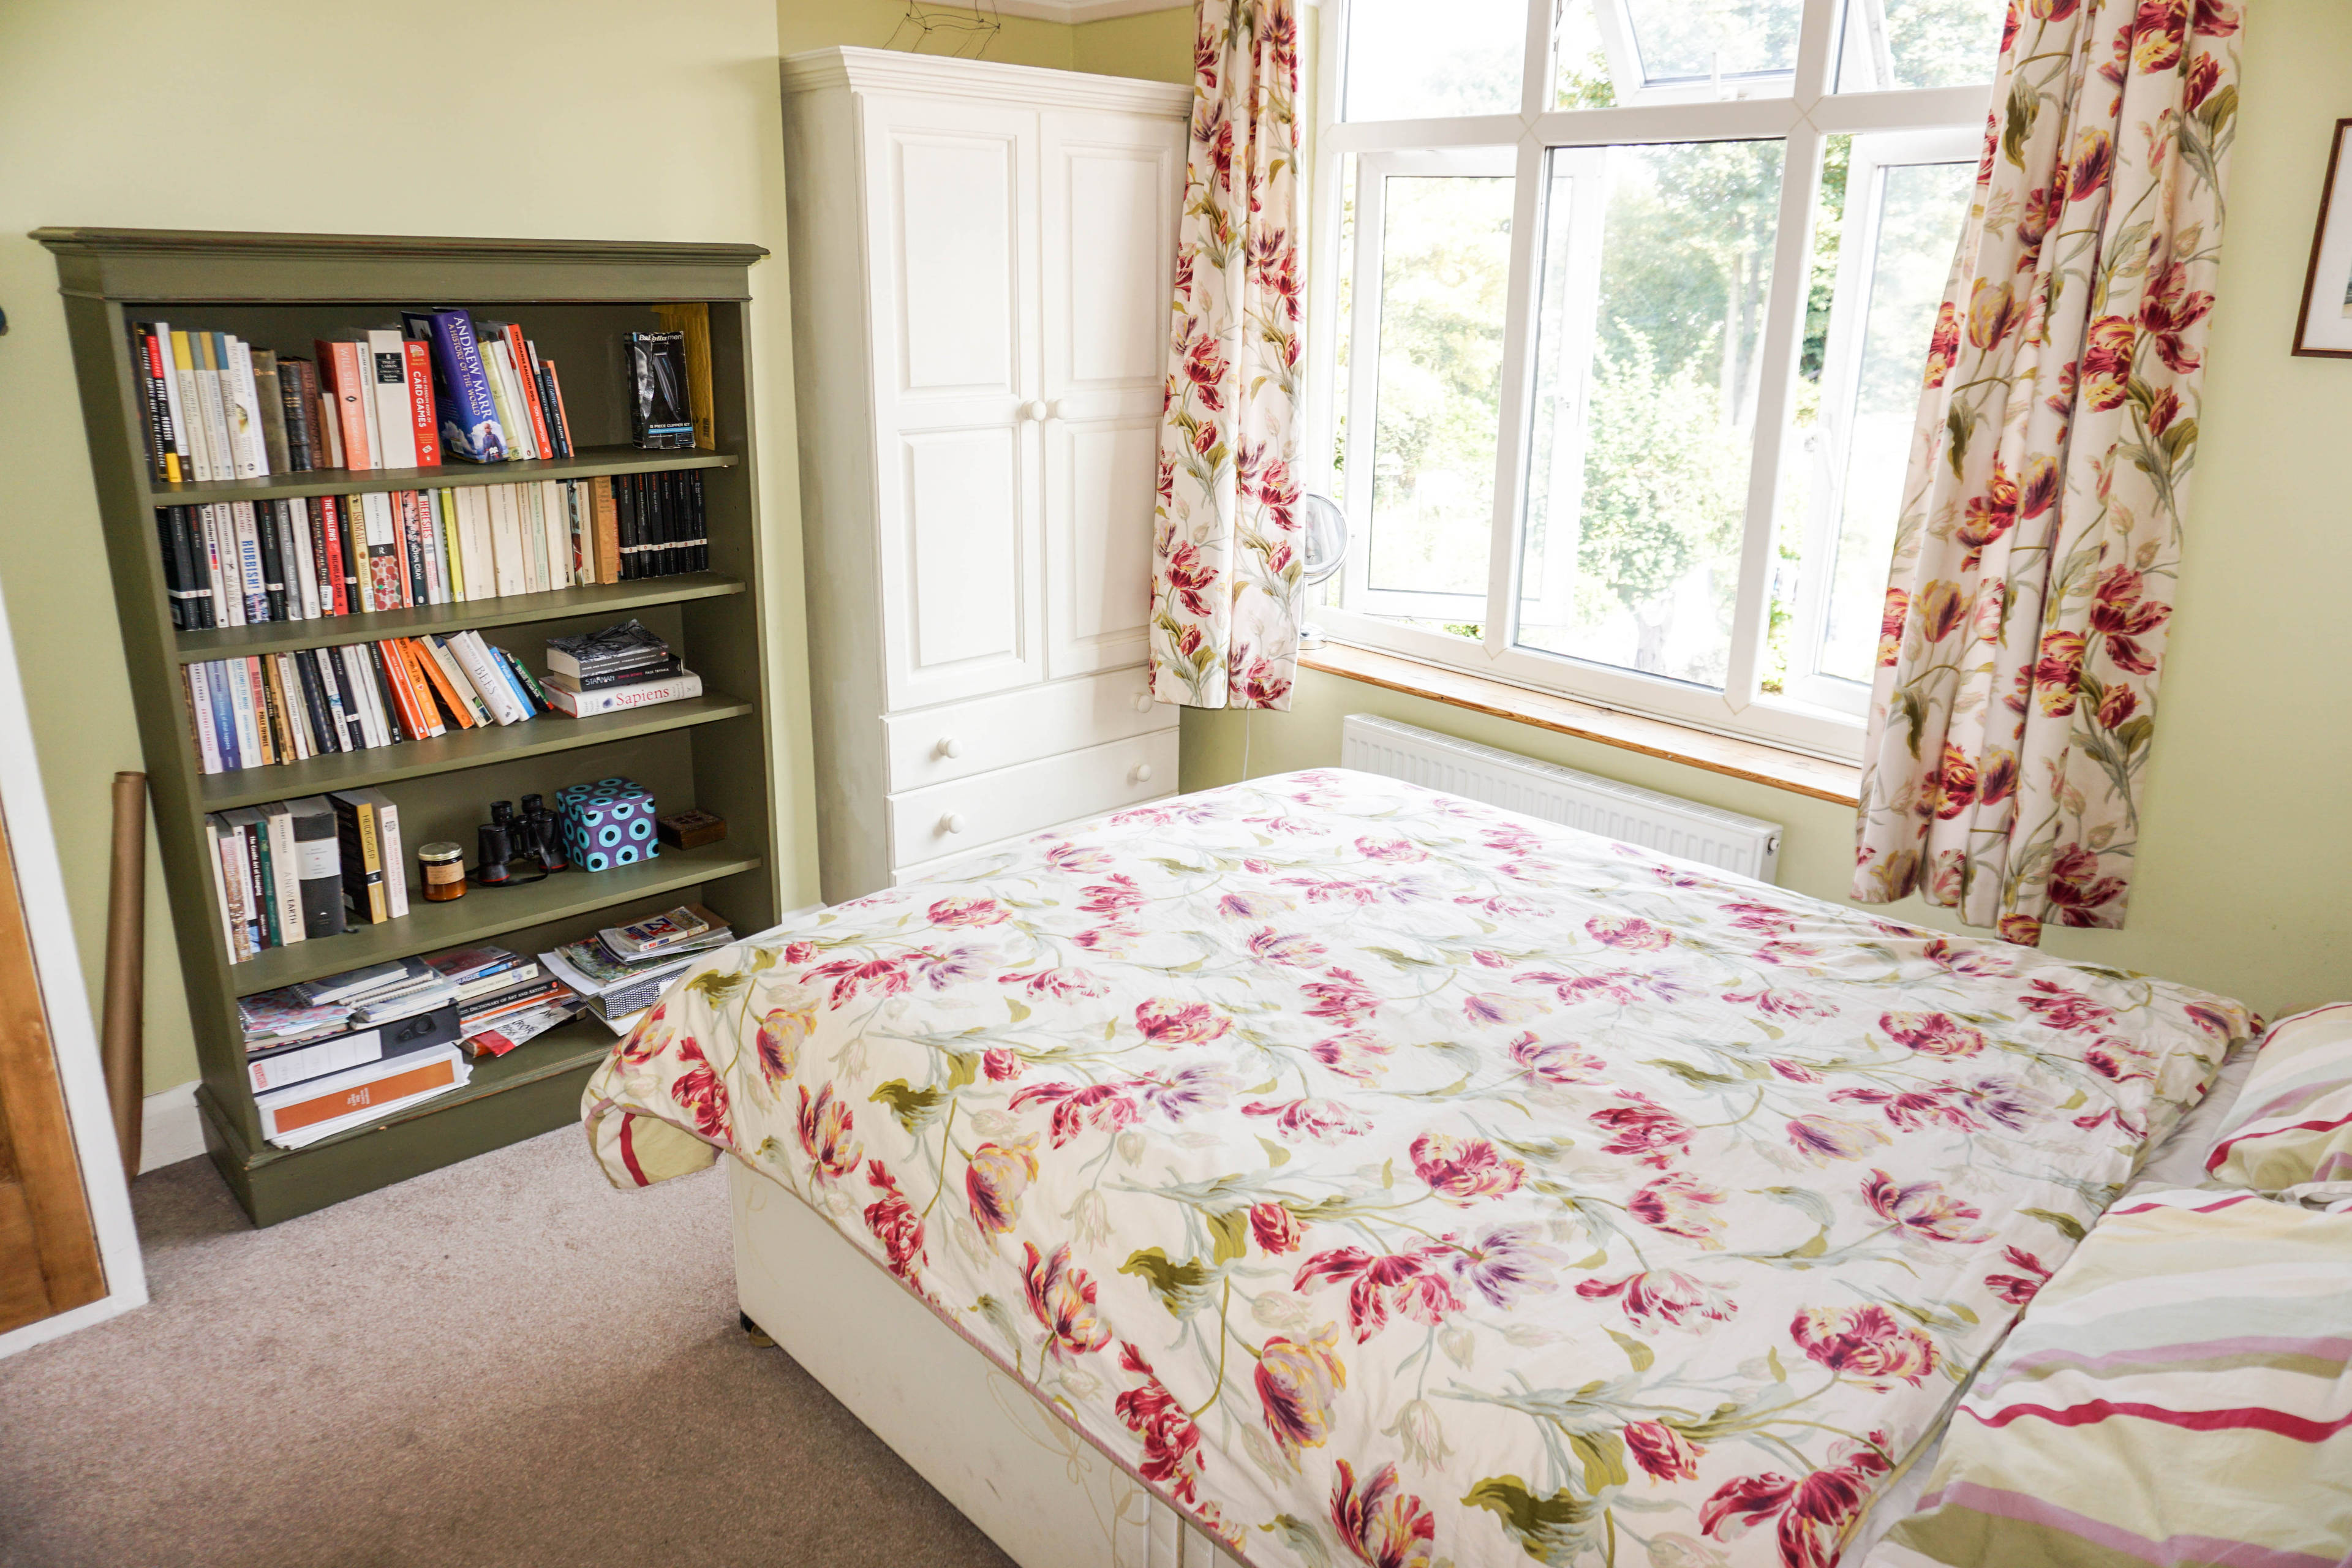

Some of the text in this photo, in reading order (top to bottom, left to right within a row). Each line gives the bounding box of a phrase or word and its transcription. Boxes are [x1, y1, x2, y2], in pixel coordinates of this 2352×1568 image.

[450, 329, 464, 360] HISTORY
[340, 347, 353, 393] WILL SELF
[454, 316, 492, 419] ANDREW MARR
[459, 361, 468, 372] OF
[517, 342, 526, 364] ORANGE
[523, 365, 533, 389] BALLOON
[413, 371, 423, 396] CARD
[462, 373, 472, 388] THE
[416, 397, 427, 427] GAMES
[467, 388, 480, 416] WORLD
[161, 415, 174, 440] MADNESS
[535, 417, 546, 443] THOMPSON
[325, 511, 337, 541] SHALLOWS
[420, 500, 432, 539] HERESIES
[241, 540, 260, 589] RUBBISH!
[331, 554, 341, 582] NICHOLAS
[410, 543, 423, 580] JOHN GRAY
[475, 666, 497, 695] BEES
[501, 665, 512, 679] Polish
[585, 675, 616, 686] STARMAN
[616, 687, 670, 707] Sapiens
[334, 710, 343, 724] CHRIS
[259, 726, 268, 747] TOYNBEE
[361, 814, 375, 859] HEIDEGGER
[253, 874, 263, 895] Tramping
[286, 898, 298, 924] EARTH
[624, 925, 656, 942] LONDON
[469, 1000, 499, 1011] DICTIONARY
[529, 985, 548, 995] ARTISTS
